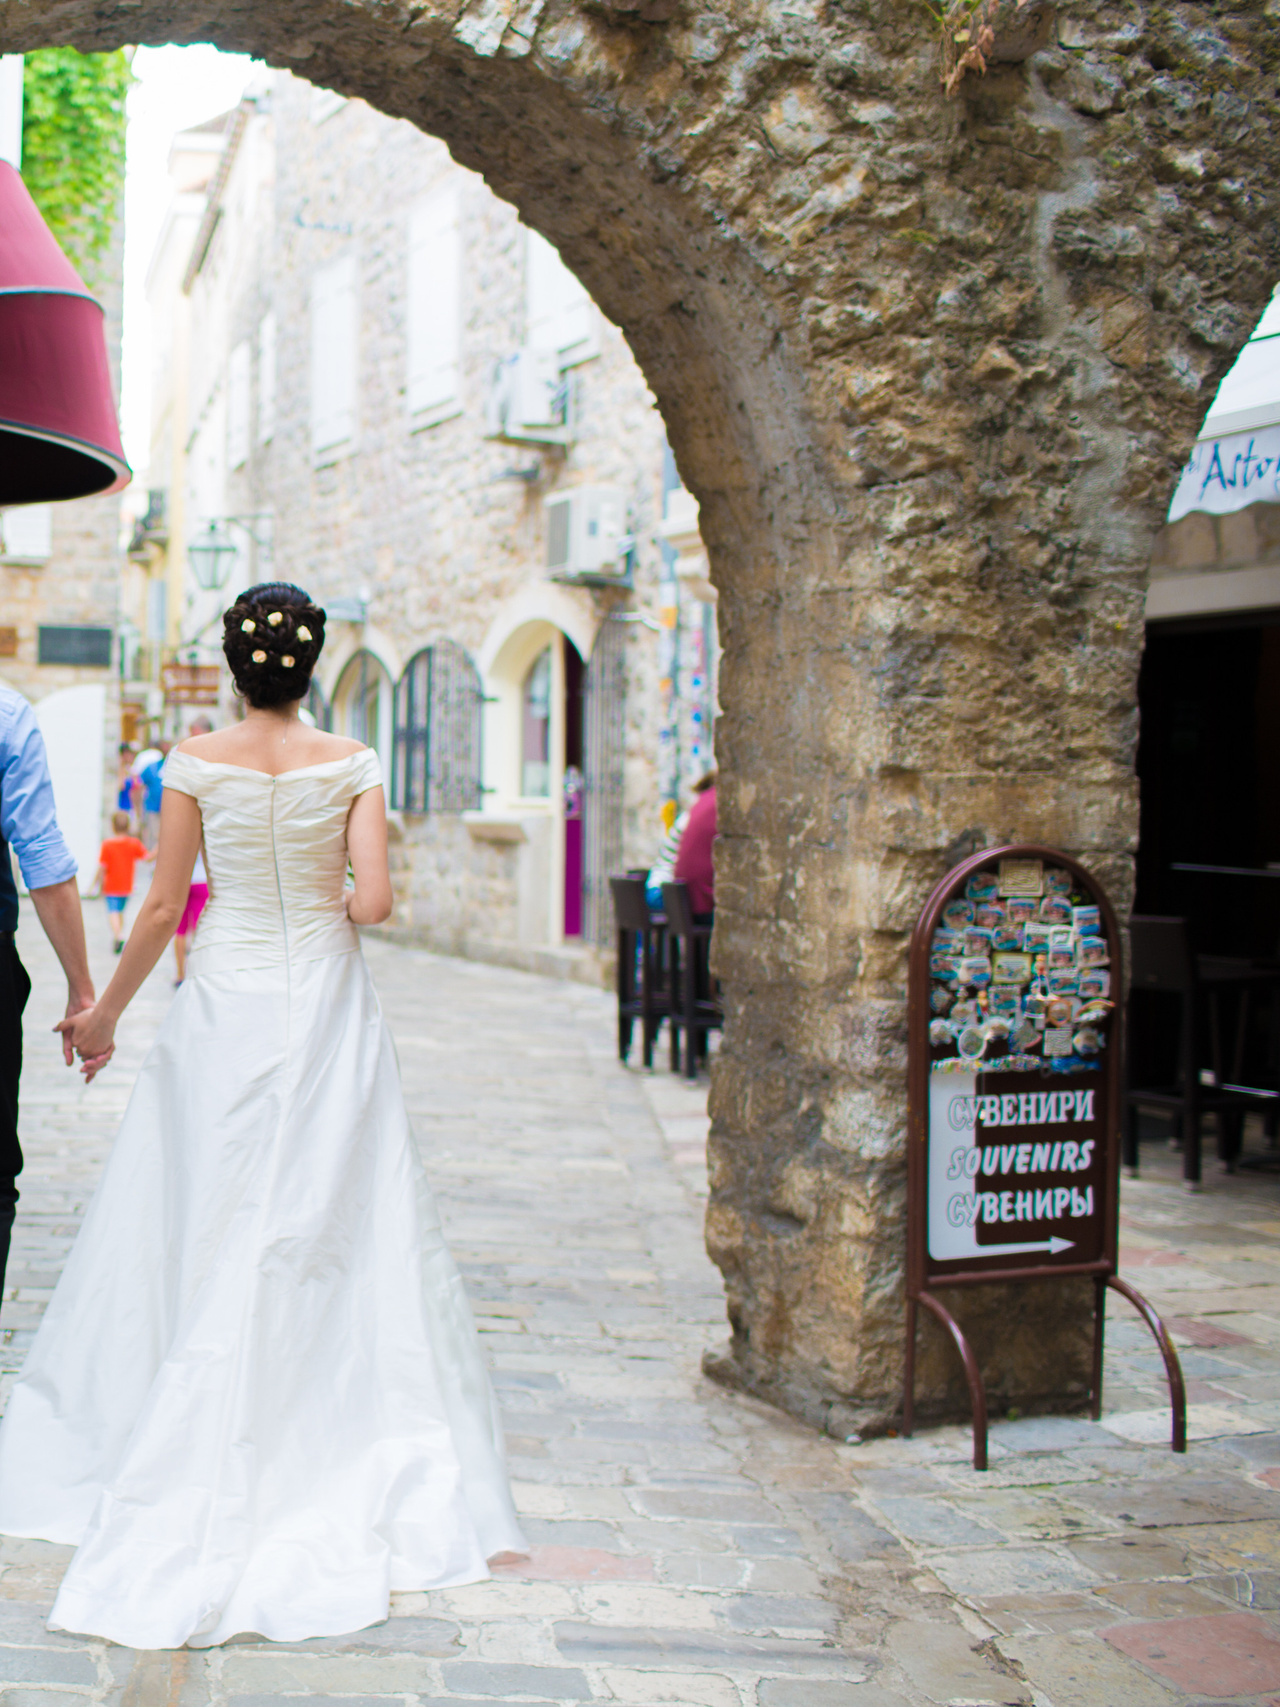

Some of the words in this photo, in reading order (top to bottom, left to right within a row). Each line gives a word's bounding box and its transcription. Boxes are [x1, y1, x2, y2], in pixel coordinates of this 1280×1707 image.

[949, 1090, 1095, 1130] СУВЕНИРИ
[947, 1139, 1095, 1180] SOUVENIRS
[946, 1185, 1094, 1227] СУВЕНИРЫ
